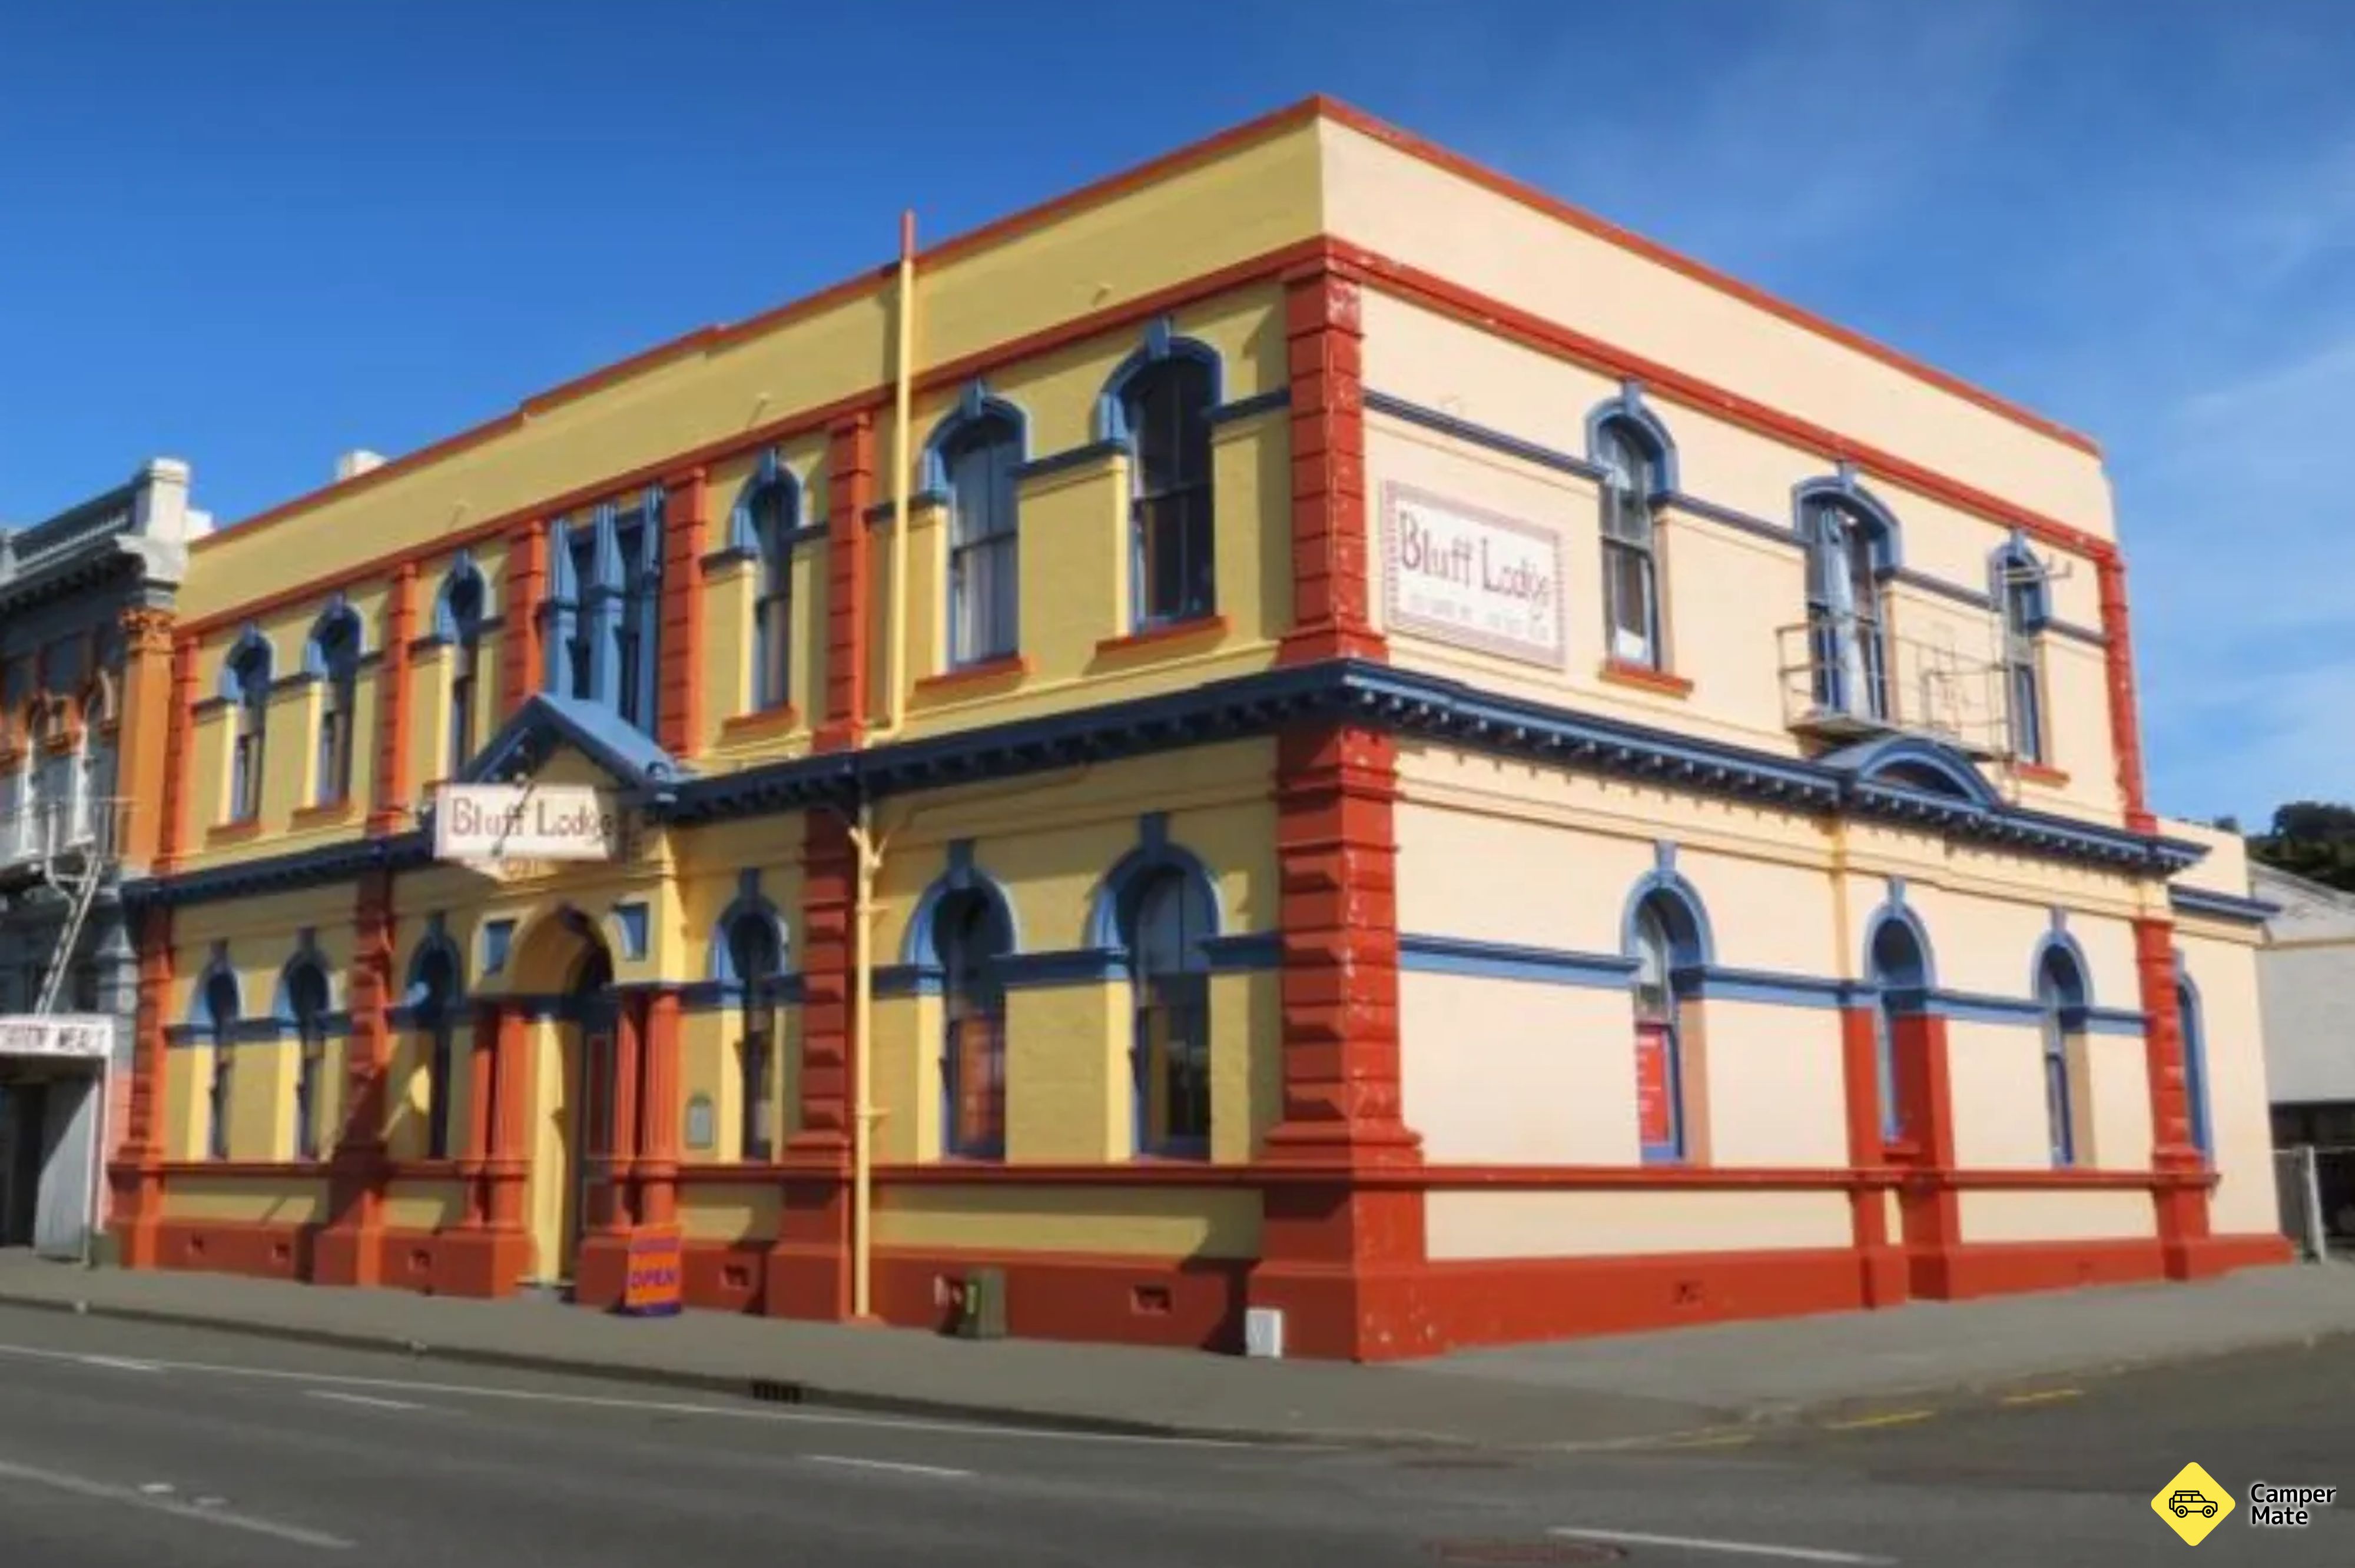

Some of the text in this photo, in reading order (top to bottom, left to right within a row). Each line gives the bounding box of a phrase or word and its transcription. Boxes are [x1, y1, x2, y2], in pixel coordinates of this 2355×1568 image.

[1398, 510, 1472, 589] Bluff
[452, 796, 615, 843] Bluff Lodge
